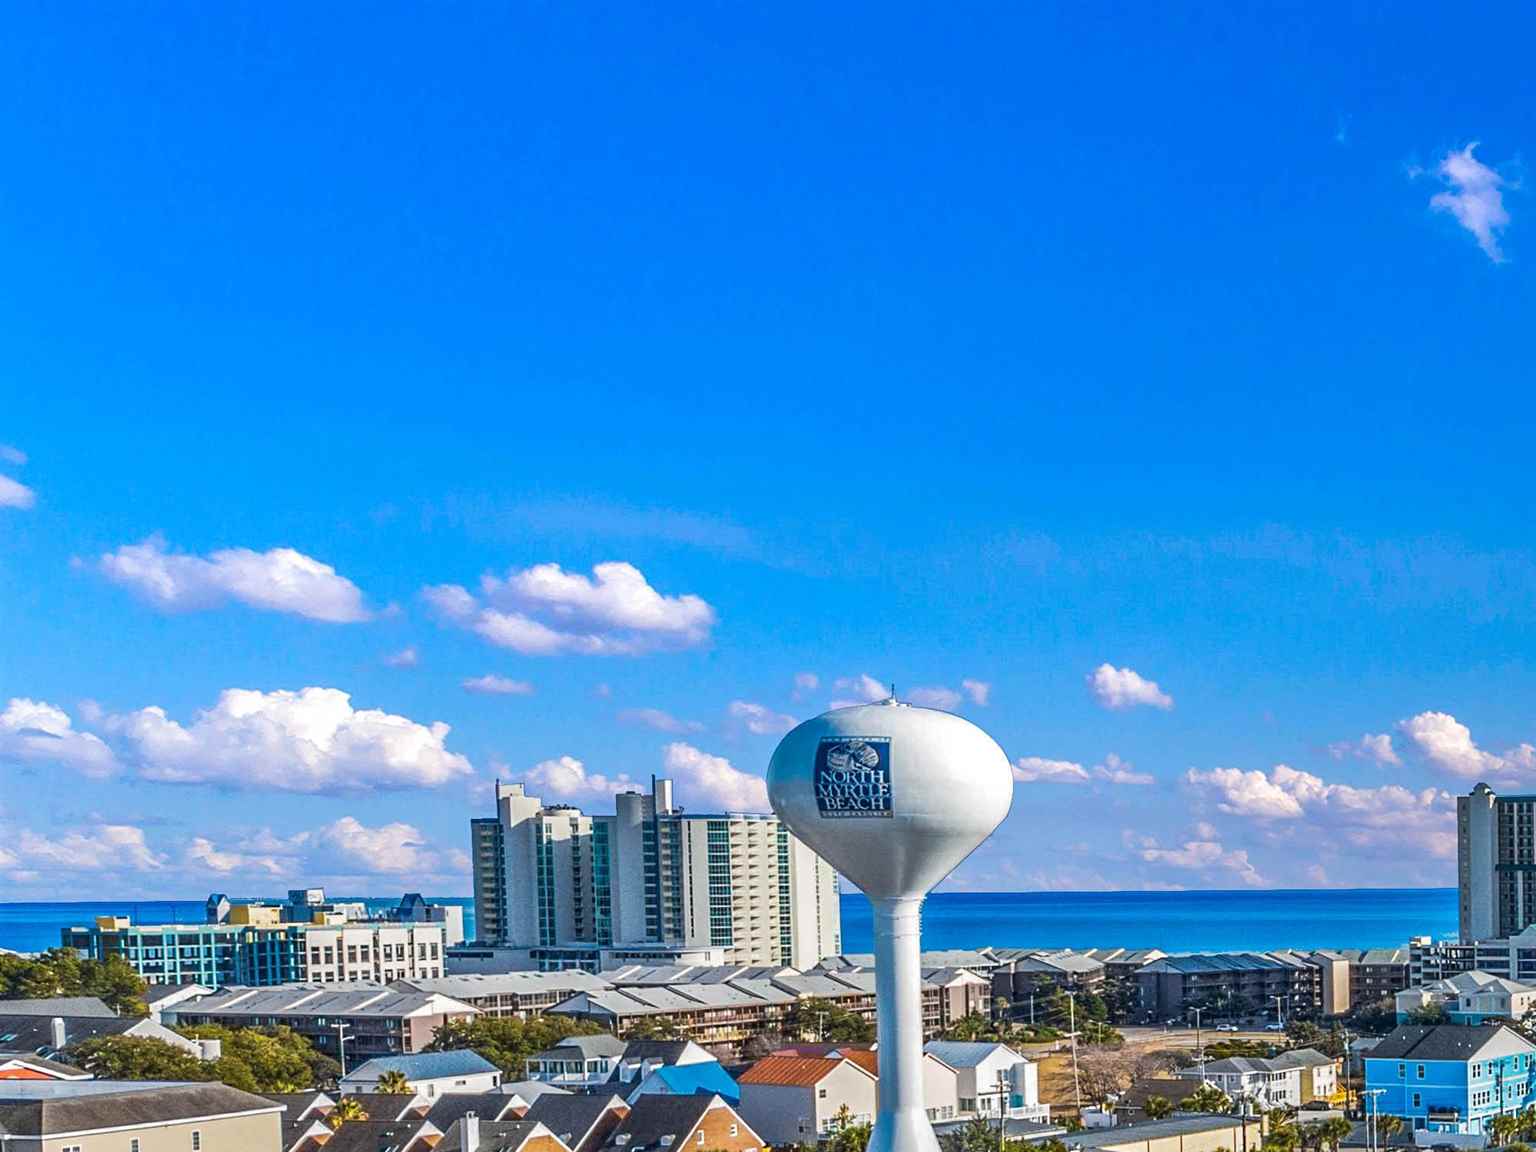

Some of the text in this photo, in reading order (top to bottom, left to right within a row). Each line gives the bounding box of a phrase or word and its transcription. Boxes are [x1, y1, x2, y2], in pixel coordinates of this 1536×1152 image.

[820, 769, 885, 785] NORTH
[818, 783, 889, 799] MYRTLE
[824, 797, 885, 810] BEACH
